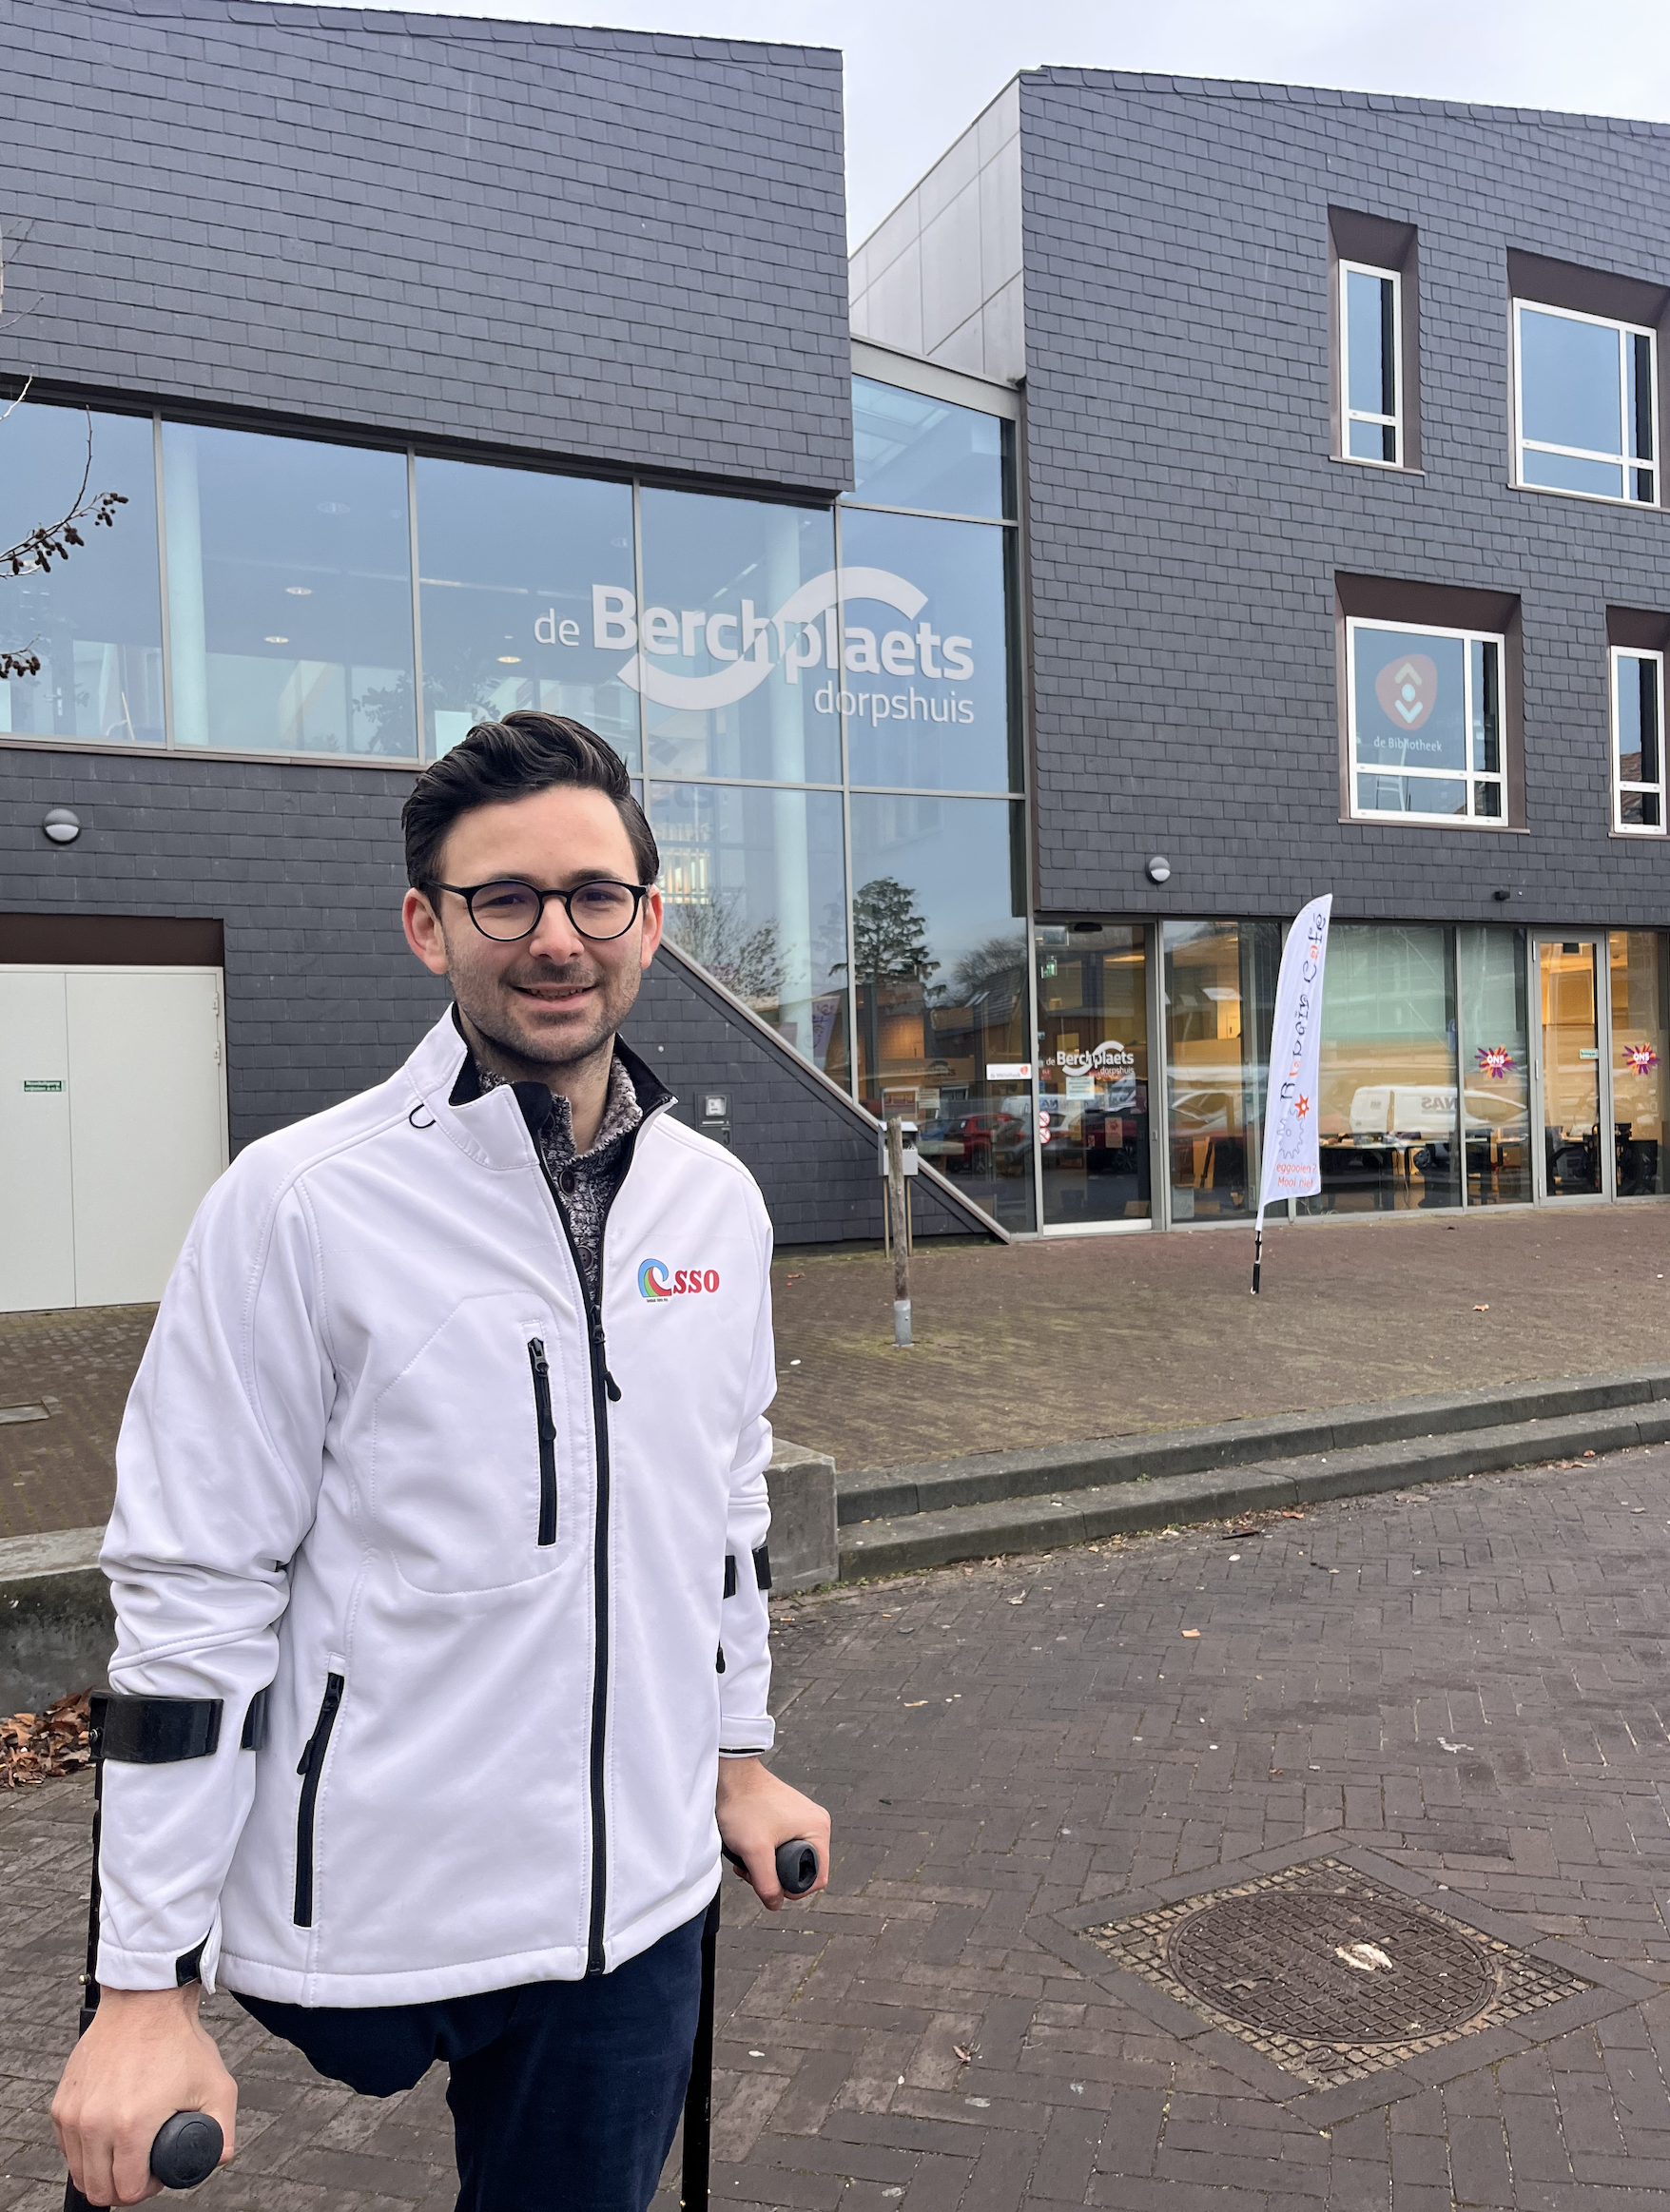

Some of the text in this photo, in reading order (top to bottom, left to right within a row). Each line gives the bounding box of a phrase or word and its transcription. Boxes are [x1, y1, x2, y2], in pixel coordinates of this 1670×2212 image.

[534, 583, 975, 685] de Berchplaets
[815, 681, 975, 728] dorpshuis
[1373, 736, 1443, 752] de Bibliotheek
[1046, 1050, 1135, 1069] de Berchplaets
[1486, 1055, 1505, 1064] ONS
[1633, 1052, 1650, 1062] ONS
[1100, 1066, 1135, 1077] dorpshuis
[1275, 1162, 1317, 1174] eggooien?
[673, 1270, 720, 1294] SSO
